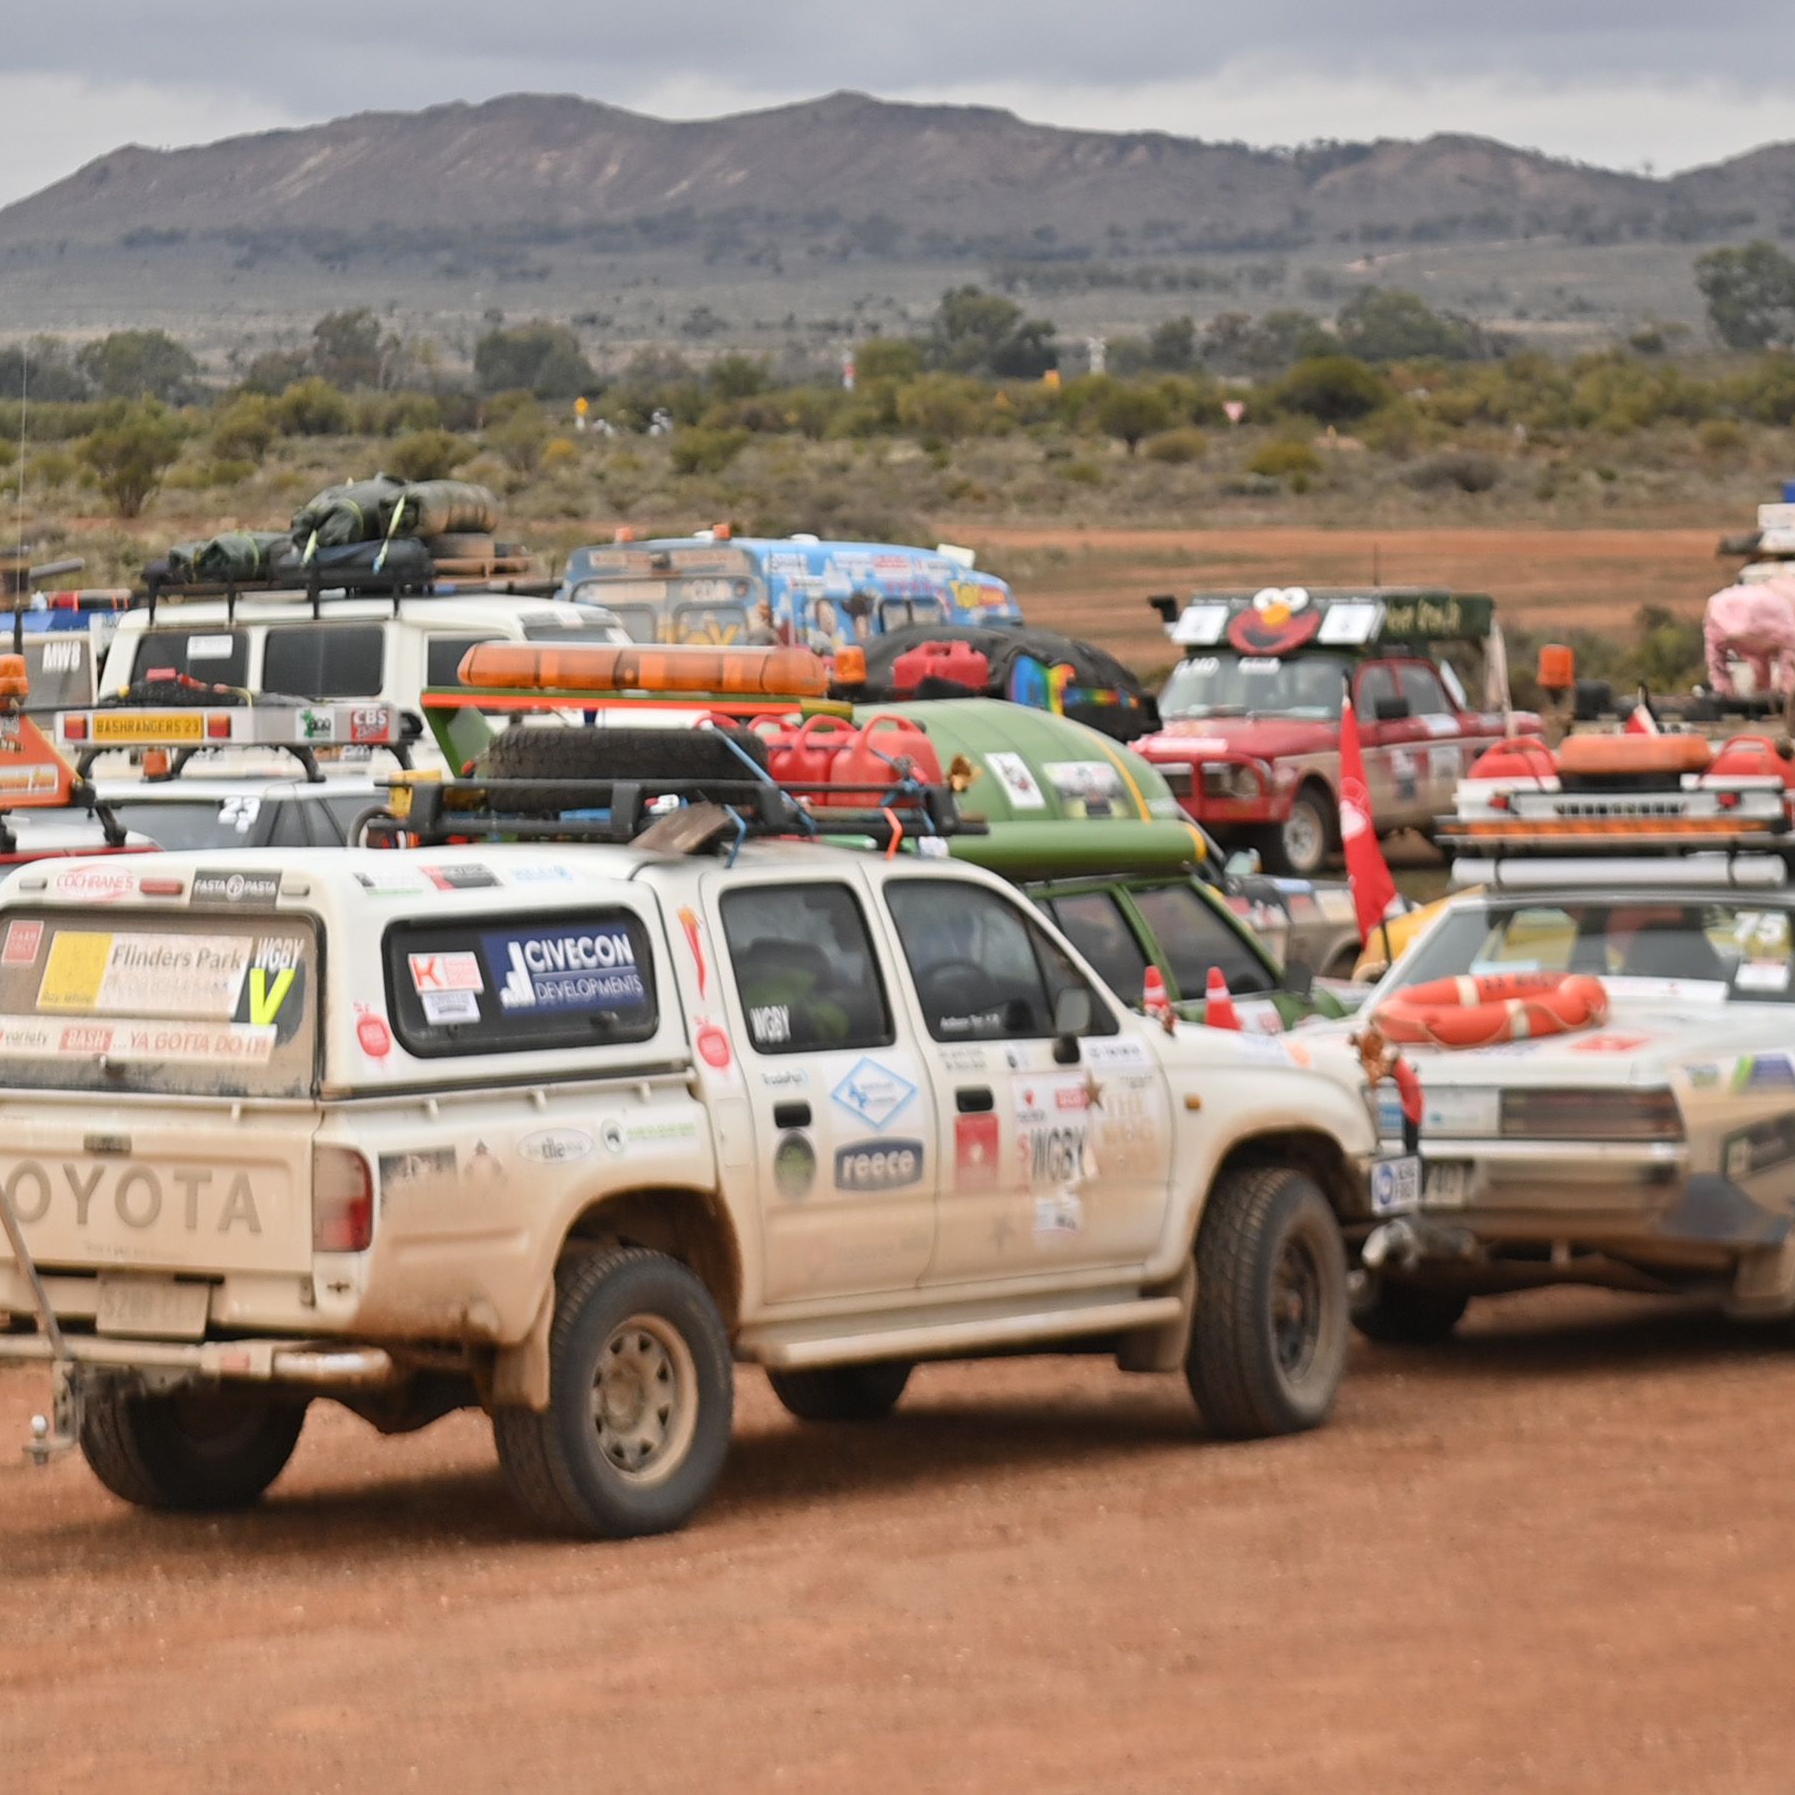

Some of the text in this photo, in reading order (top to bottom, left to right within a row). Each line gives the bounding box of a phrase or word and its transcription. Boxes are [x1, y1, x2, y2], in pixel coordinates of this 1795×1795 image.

[352, 708, 388, 724] CBS
[194, 878, 226, 892] FASTA
[244, 879, 276, 893] PASTA
[1737, 910, 1786, 942] 75
[110, 944, 242, 970] Flinders Park
[523, 933, 636, 973] CIVECON
[534, 974, 644, 1001] DEVELOPMENTS
[4, 1029, 50, 1047] variety
[67, 1027, 105, 1047] BASH
[154, 1032, 210, 1053] GOTTA
[214, 1034, 242, 1054] DO
[842, 1148, 916, 1179] reece
